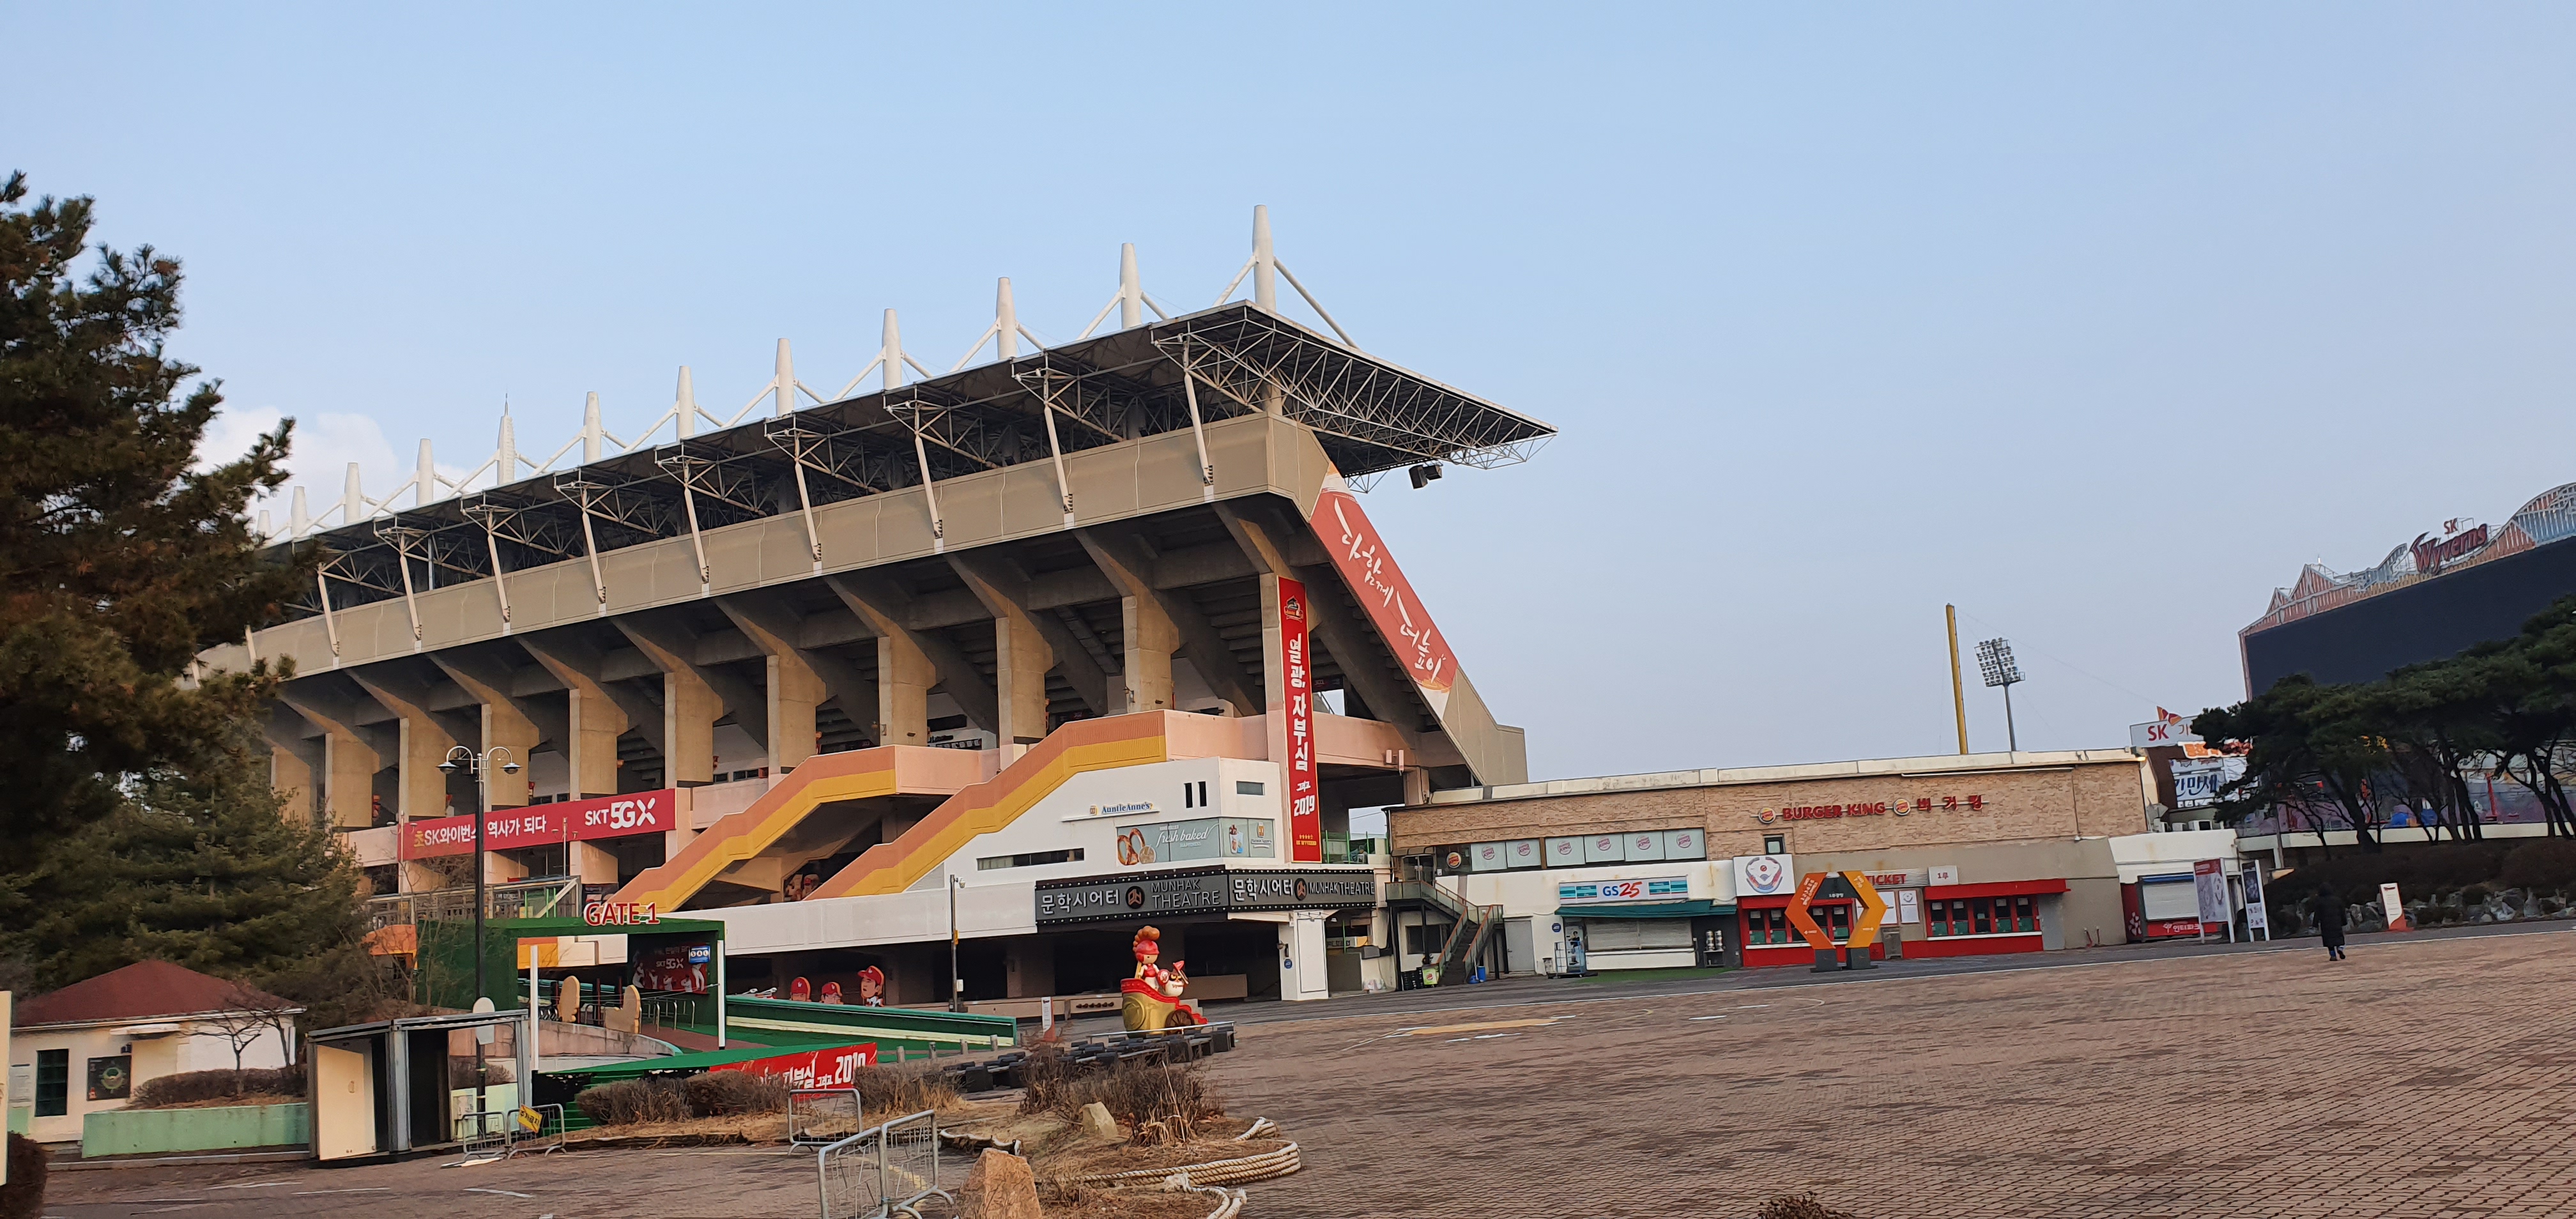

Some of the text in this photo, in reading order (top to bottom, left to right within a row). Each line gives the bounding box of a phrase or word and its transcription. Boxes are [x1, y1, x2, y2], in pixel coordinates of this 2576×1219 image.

[2444, 518, 2458, 534] SK
[1334, 497, 1394, 608] 다함께
[2410, 523, 2487, 576] Wyverns
[1292, 692, 1308, 772] 자부심
[2147, 724, 2169, 741] SK
[585, 797, 656, 829] SKT 5GX
[1294, 795, 1315, 816] 2019
[1782, 805, 1843, 821] BURGER
[1847, 802, 1886, 817] KING
[487, 817, 521, 838] 역사가
[524, 814, 547, 834] 되다
[1156, 827, 1209, 848] fresh baked
[1151, 878, 1200, 893] MUNHAK
[1234, 878, 1293, 901] 문학시어터
[1309, 882, 1375, 894] MUNHAK THEATRE
[1602, 881, 1643, 898] GS25
[1041, 889, 1119, 915] 문학시어터
[1152, 890, 1220, 908] THEATRE
[584, 902, 660, 926] GATE 1
